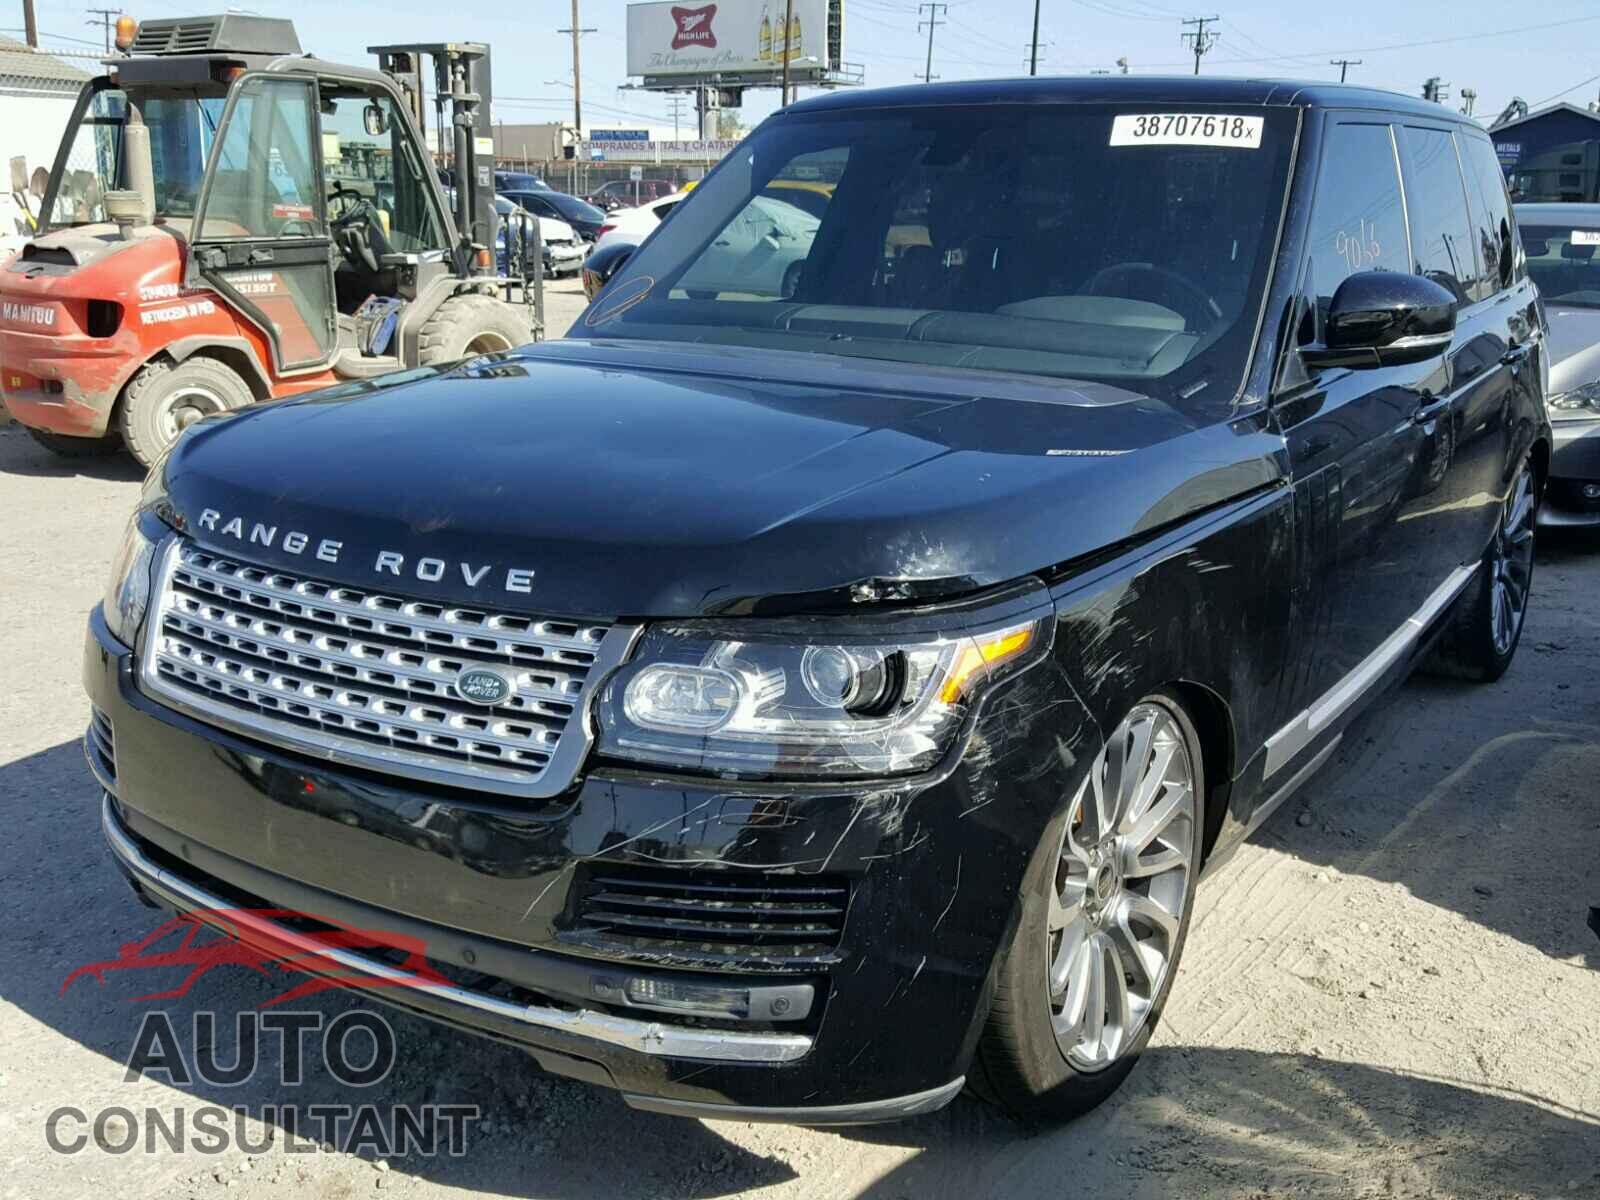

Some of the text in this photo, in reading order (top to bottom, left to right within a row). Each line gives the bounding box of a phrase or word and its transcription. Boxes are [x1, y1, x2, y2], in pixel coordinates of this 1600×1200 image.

[681, 13, 706, 31] Miller
[678, 31, 710, 40] HIGH LIFE
[581, 140, 645, 151] COMPRAMOS
[649, 139, 680, 151] MTAL
[2, 303, 55, 325] MANITOU
[198, 508, 535, 593] RANGE ROVE
[467, 675, 494, 687] LAND
[466, 685, 499, 697] ROVER
